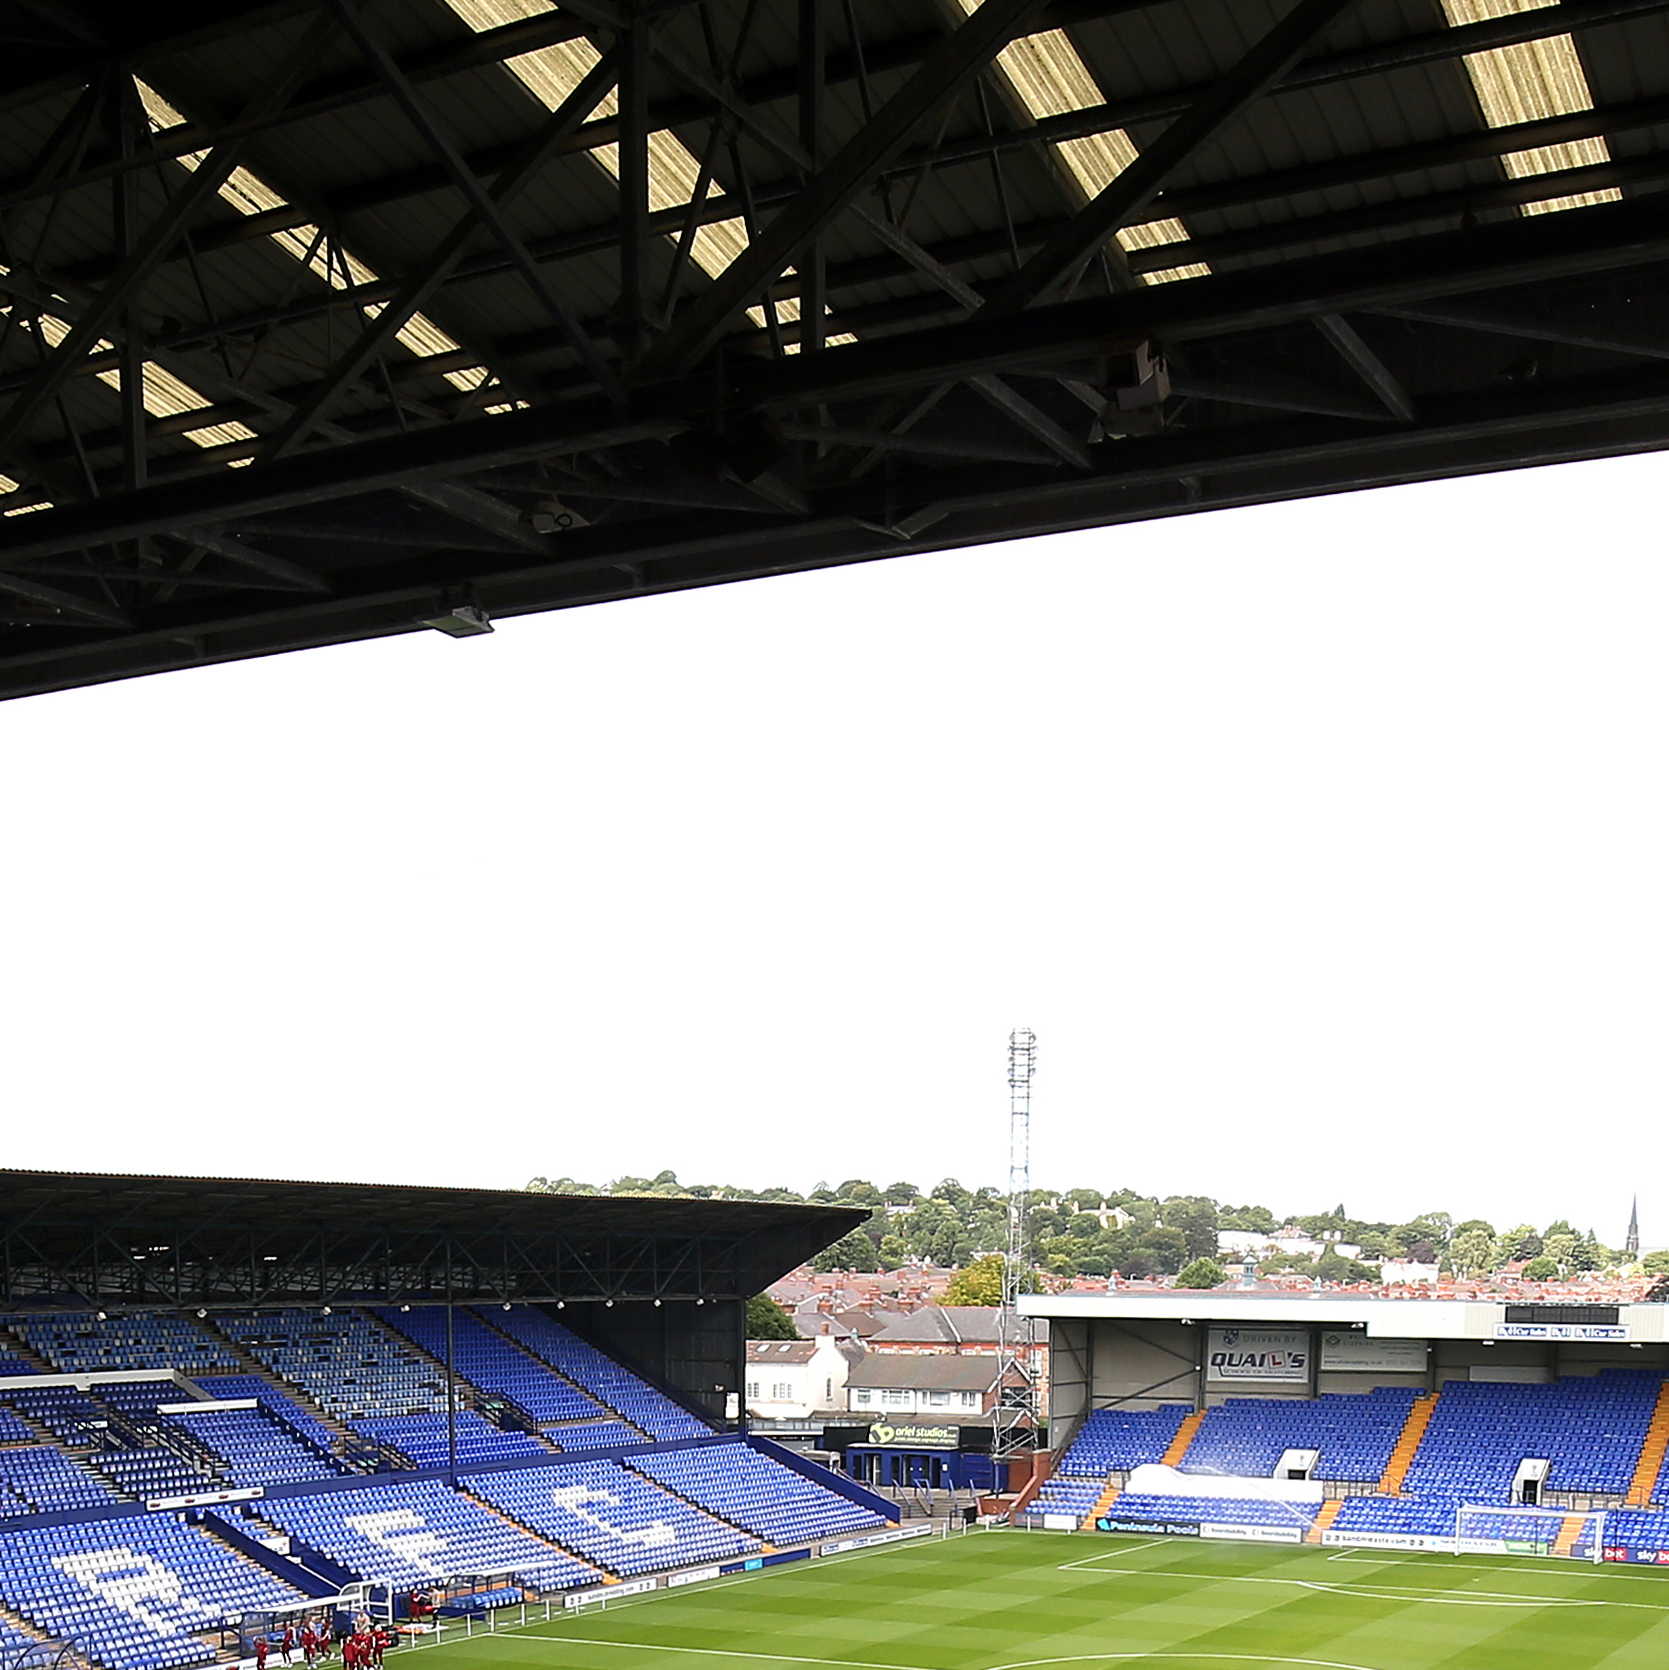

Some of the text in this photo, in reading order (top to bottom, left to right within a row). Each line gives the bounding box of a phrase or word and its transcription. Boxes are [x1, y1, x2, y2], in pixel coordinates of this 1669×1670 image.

[1242, 1335, 1297, 1343] DRIVEN BY
[1210, 1350, 1306, 1369] QUAIL'S
[895, 1425, 916, 1437] oriel
[916, 1426, 948, 1437] studios
[1637, 1550, 1657, 1562] sky
